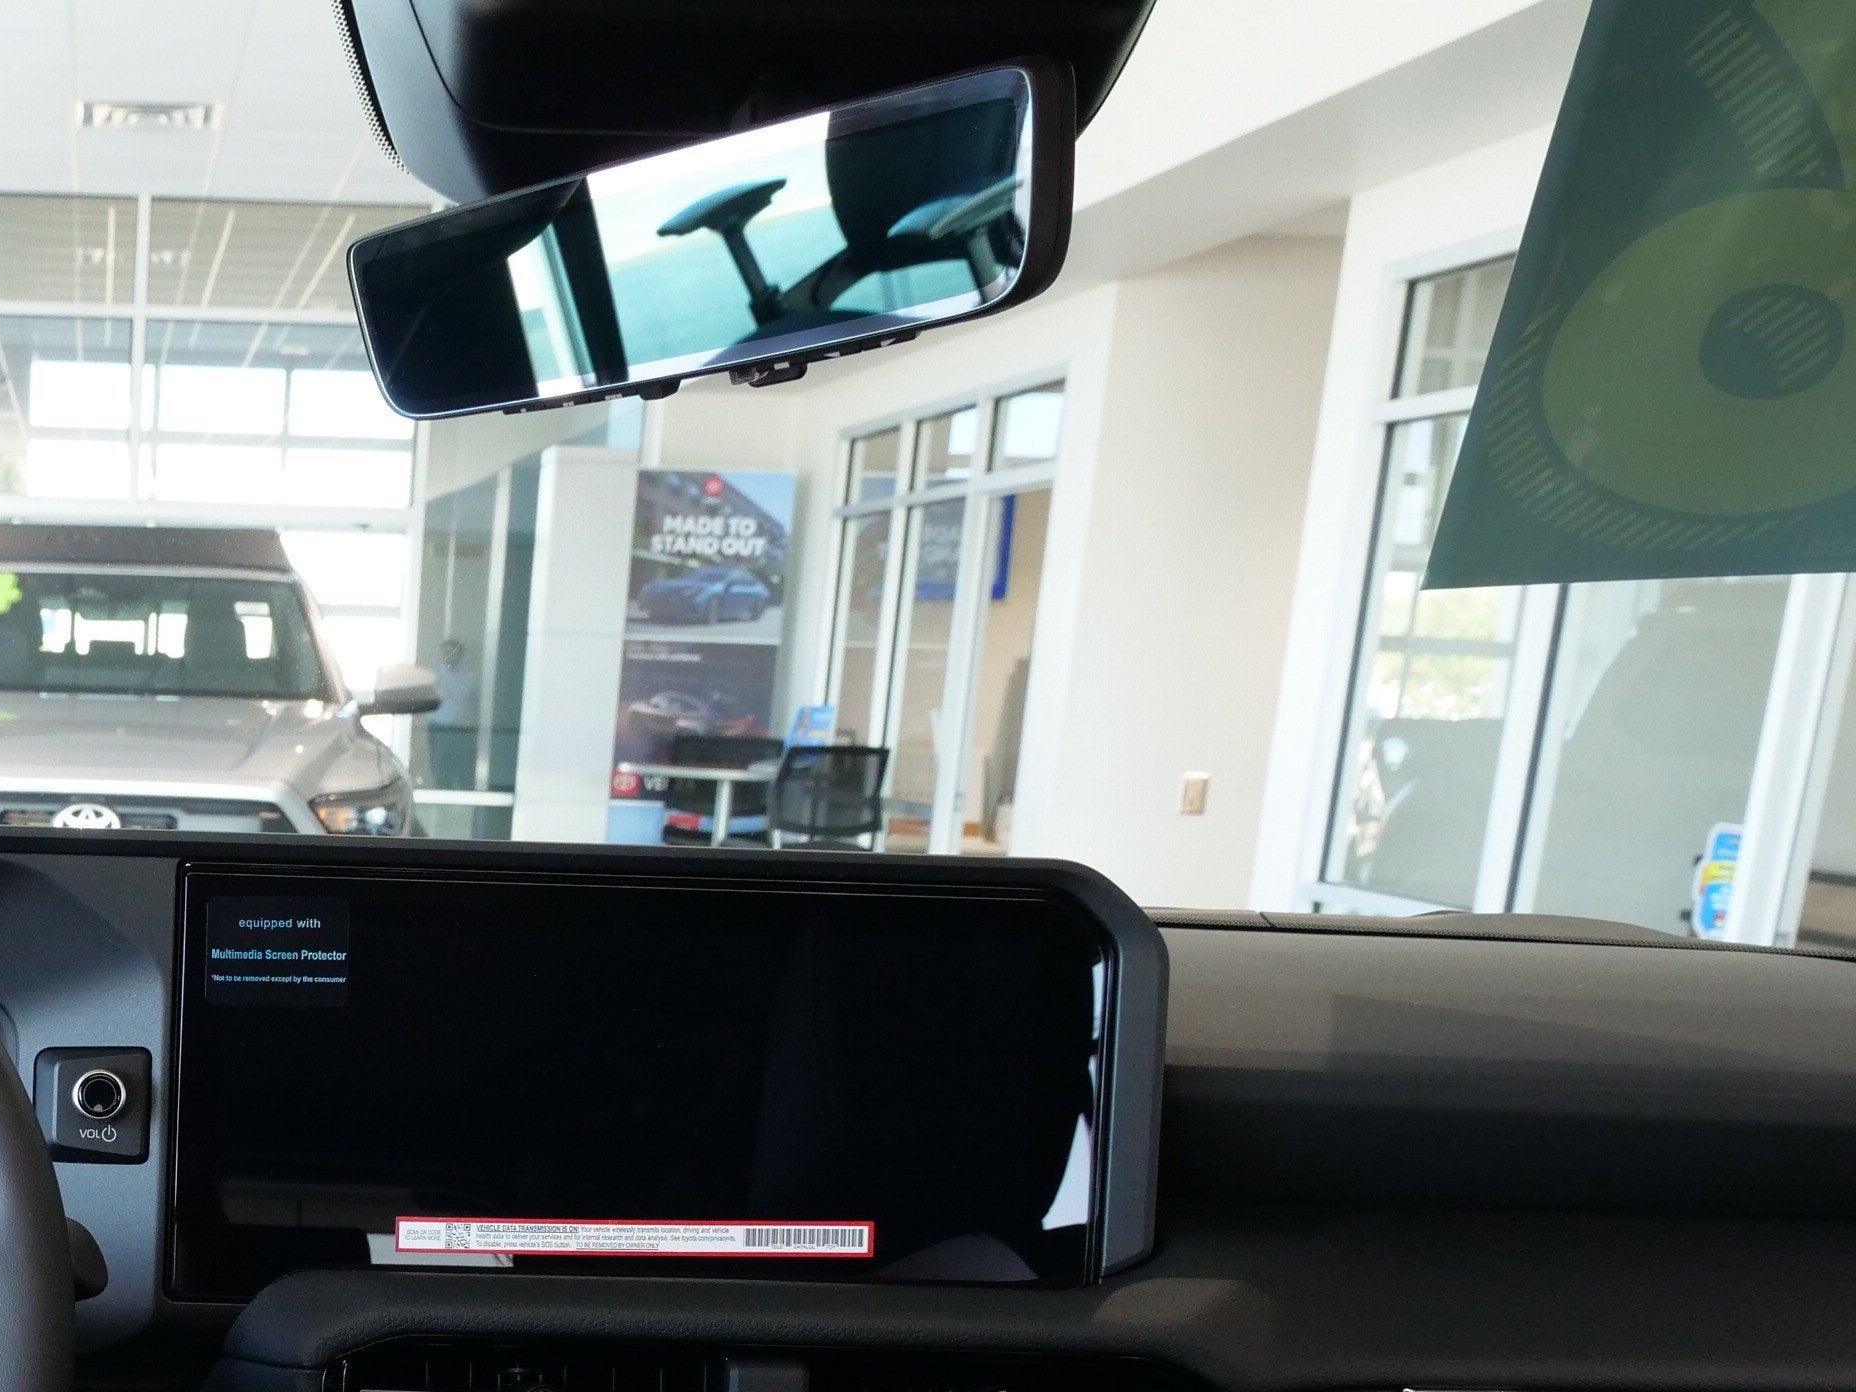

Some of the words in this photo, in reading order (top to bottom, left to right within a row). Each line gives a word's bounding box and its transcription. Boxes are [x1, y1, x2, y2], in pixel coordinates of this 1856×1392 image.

[662, 514, 726, 536] MADE
[730, 516, 758, 537] TO
[650, 533, 720, 556] STAND
[721, 535, 768, 557] OUT
[239, 918, 292, 930] equipped
[297, 917, 320, 929] with
[211, 948, 262, 959] Multimedia
[265, 950, 298, 960] Screen
[301, 950, 346, 960] Protector
[79, 1128, 100, 1138] VOL
